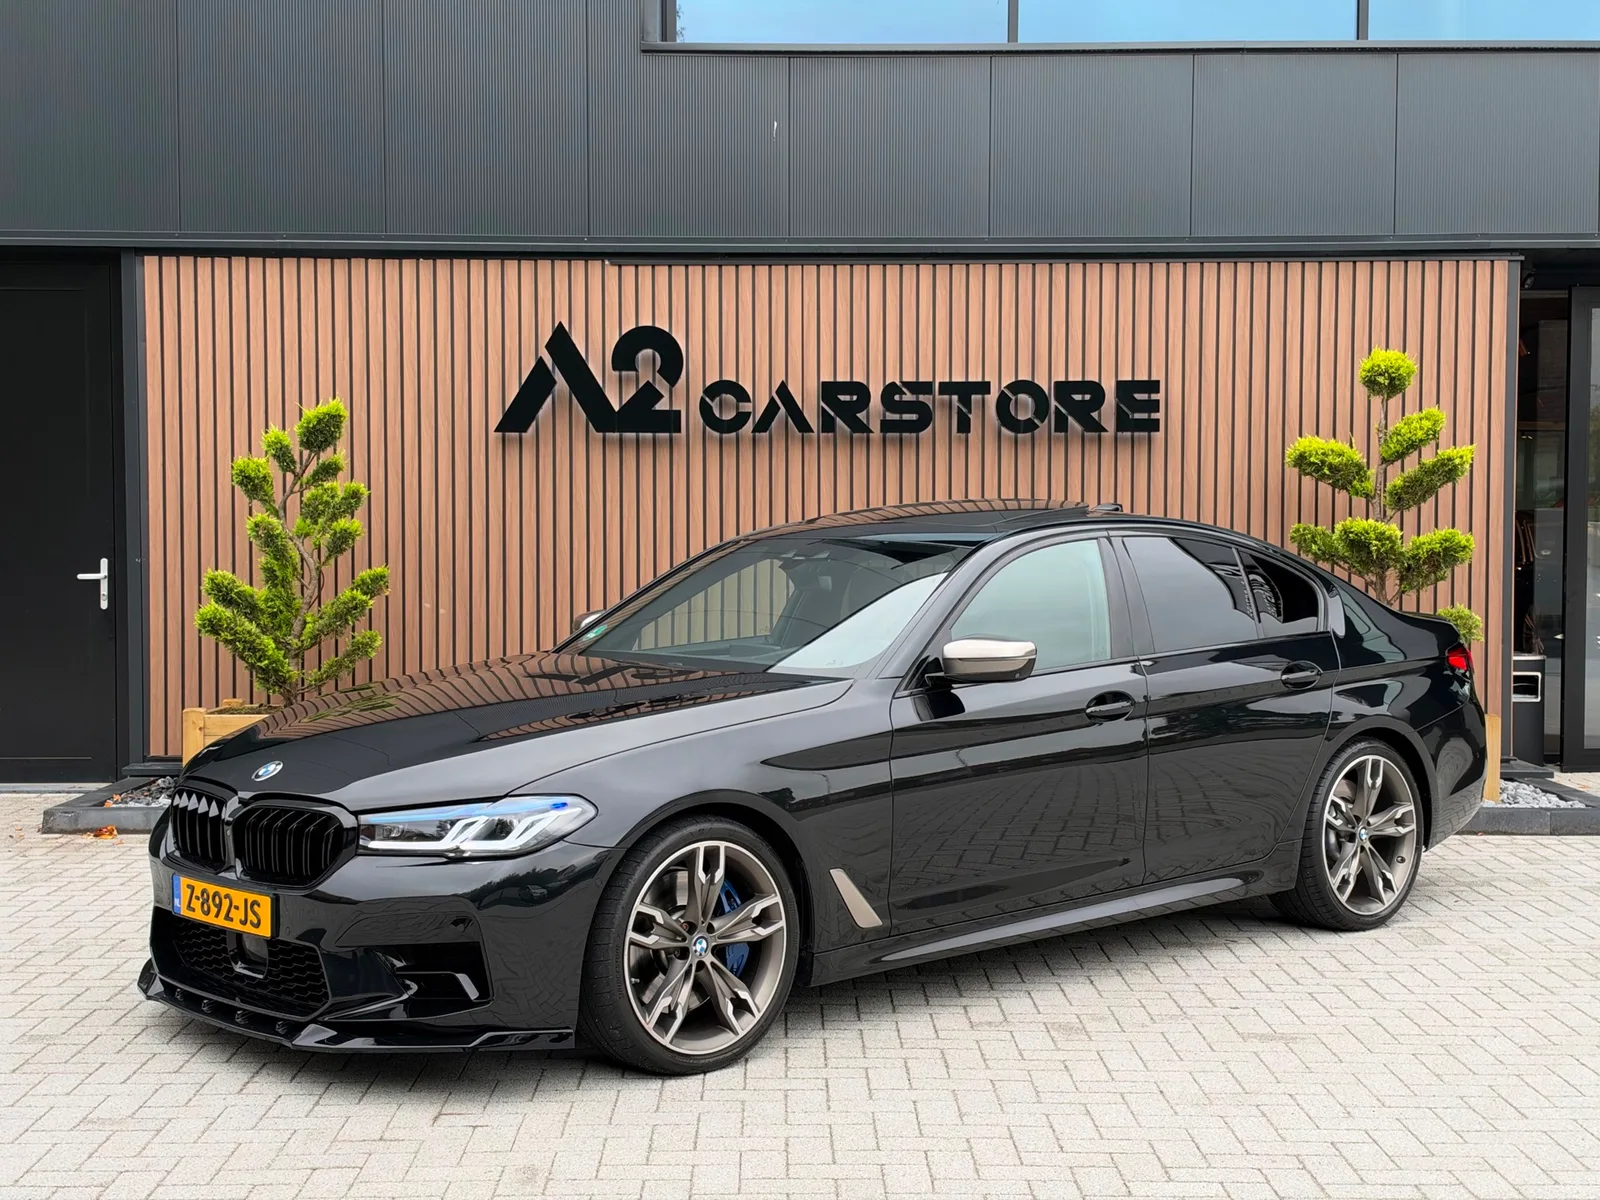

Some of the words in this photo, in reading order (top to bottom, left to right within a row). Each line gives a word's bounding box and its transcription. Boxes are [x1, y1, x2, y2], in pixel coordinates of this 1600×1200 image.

[494, 321, 684, 433] A2
[699, 379, 1161, 434] CARSTORE
[186, 884, 262, 929] Z-892-JS
